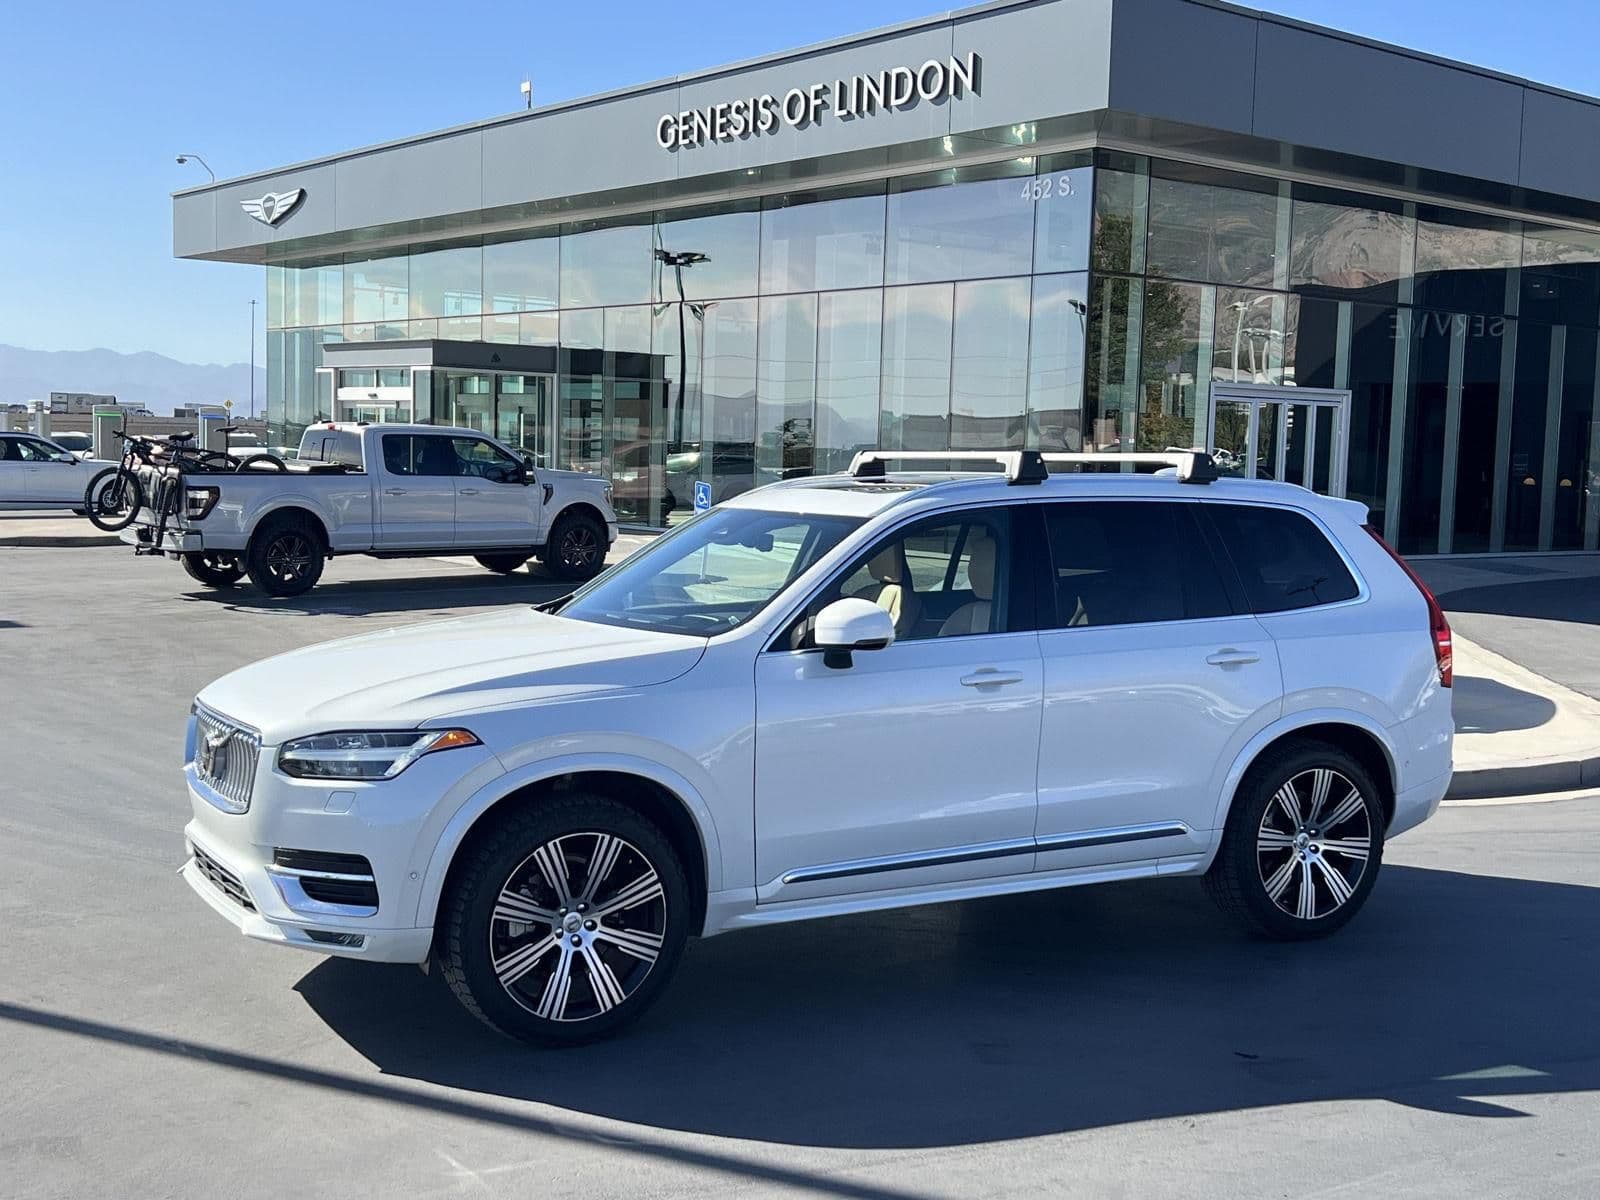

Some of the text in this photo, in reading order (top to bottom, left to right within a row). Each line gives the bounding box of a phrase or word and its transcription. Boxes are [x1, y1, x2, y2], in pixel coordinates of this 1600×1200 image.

[656, 51, 977, 149] GENESIS OF LINDON
[1021, 175, 1075, 201] 452 S.
